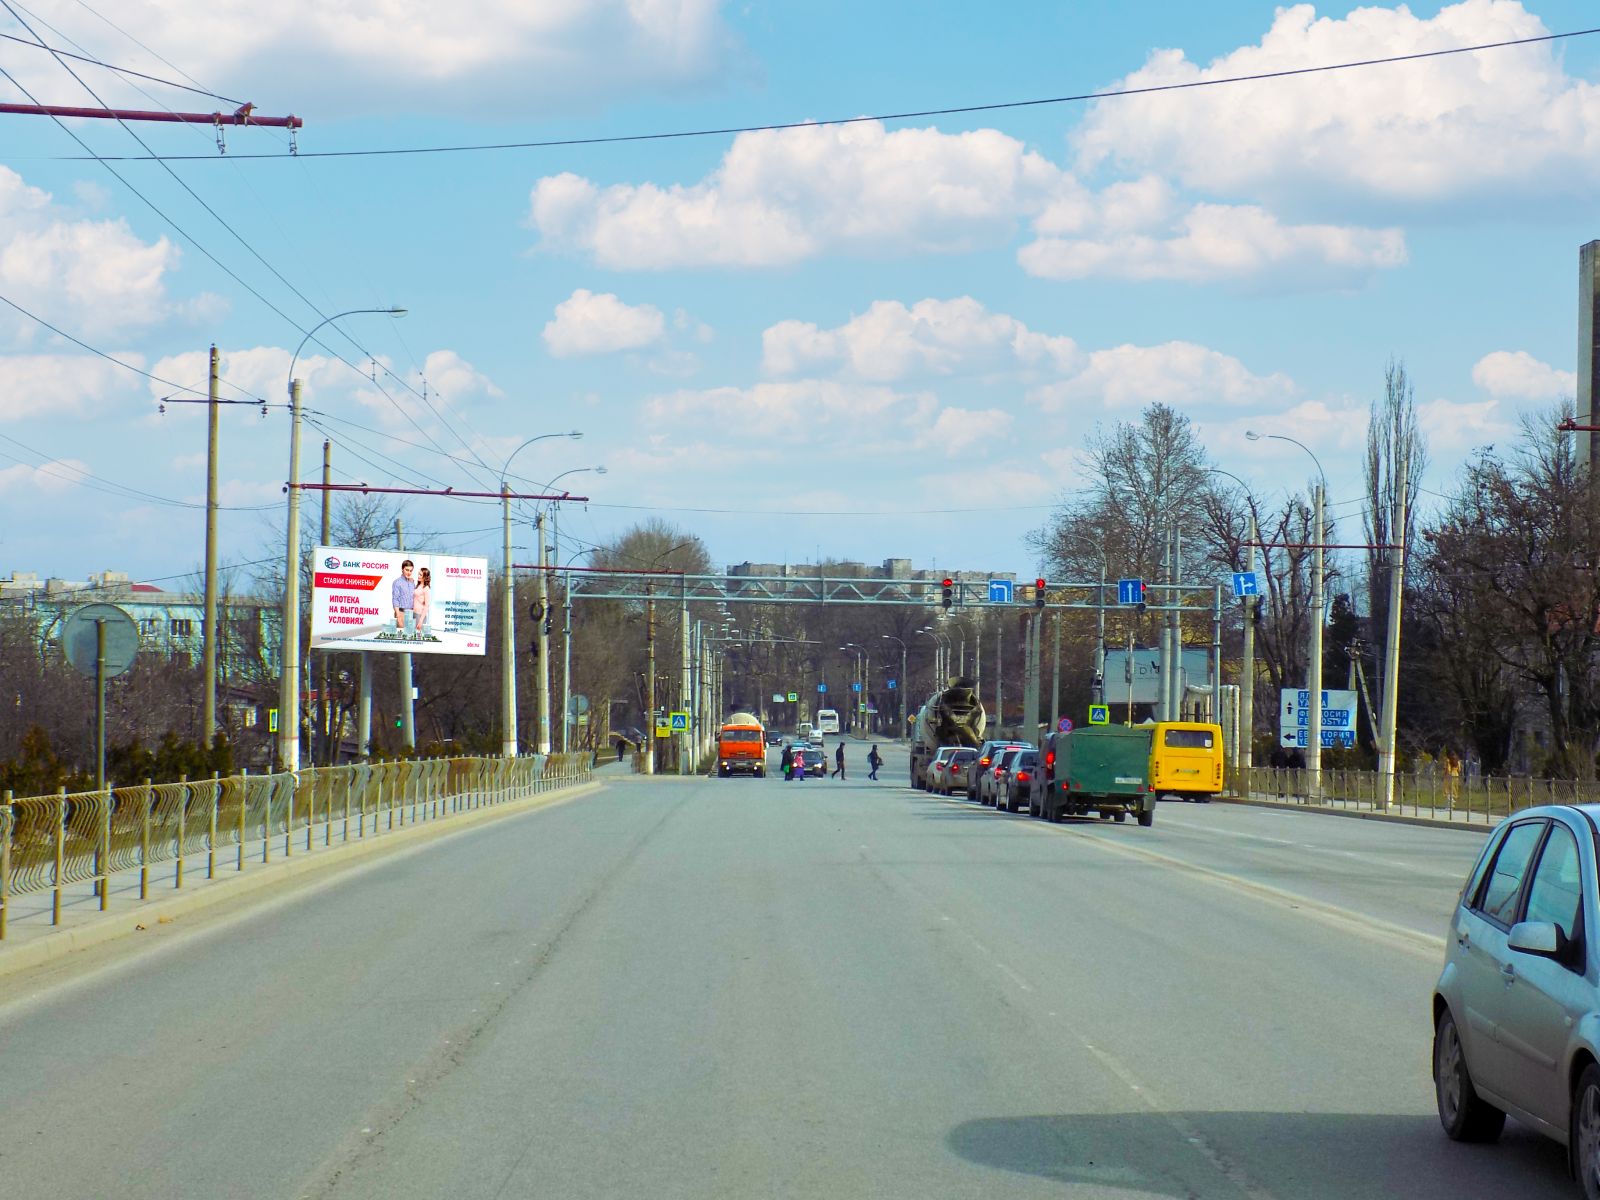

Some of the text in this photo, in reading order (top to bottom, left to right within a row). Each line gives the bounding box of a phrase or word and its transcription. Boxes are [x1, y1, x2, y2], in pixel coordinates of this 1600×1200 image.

[342, 560, 389, 570] БАНК РОССИЯ
[323, 576, 344, 585] СТАВКИ
[329, 595, 360, 604] ИПОТЕКА
[328, 605, 379, 616] НА ВЫГОДНЫХ
[328, 616, 364, 625] УСЛОВИЯХ
[1299, 699, 1327, 707] YAA
[1299, 710, 1348, 718] ФЕОСИЯ
